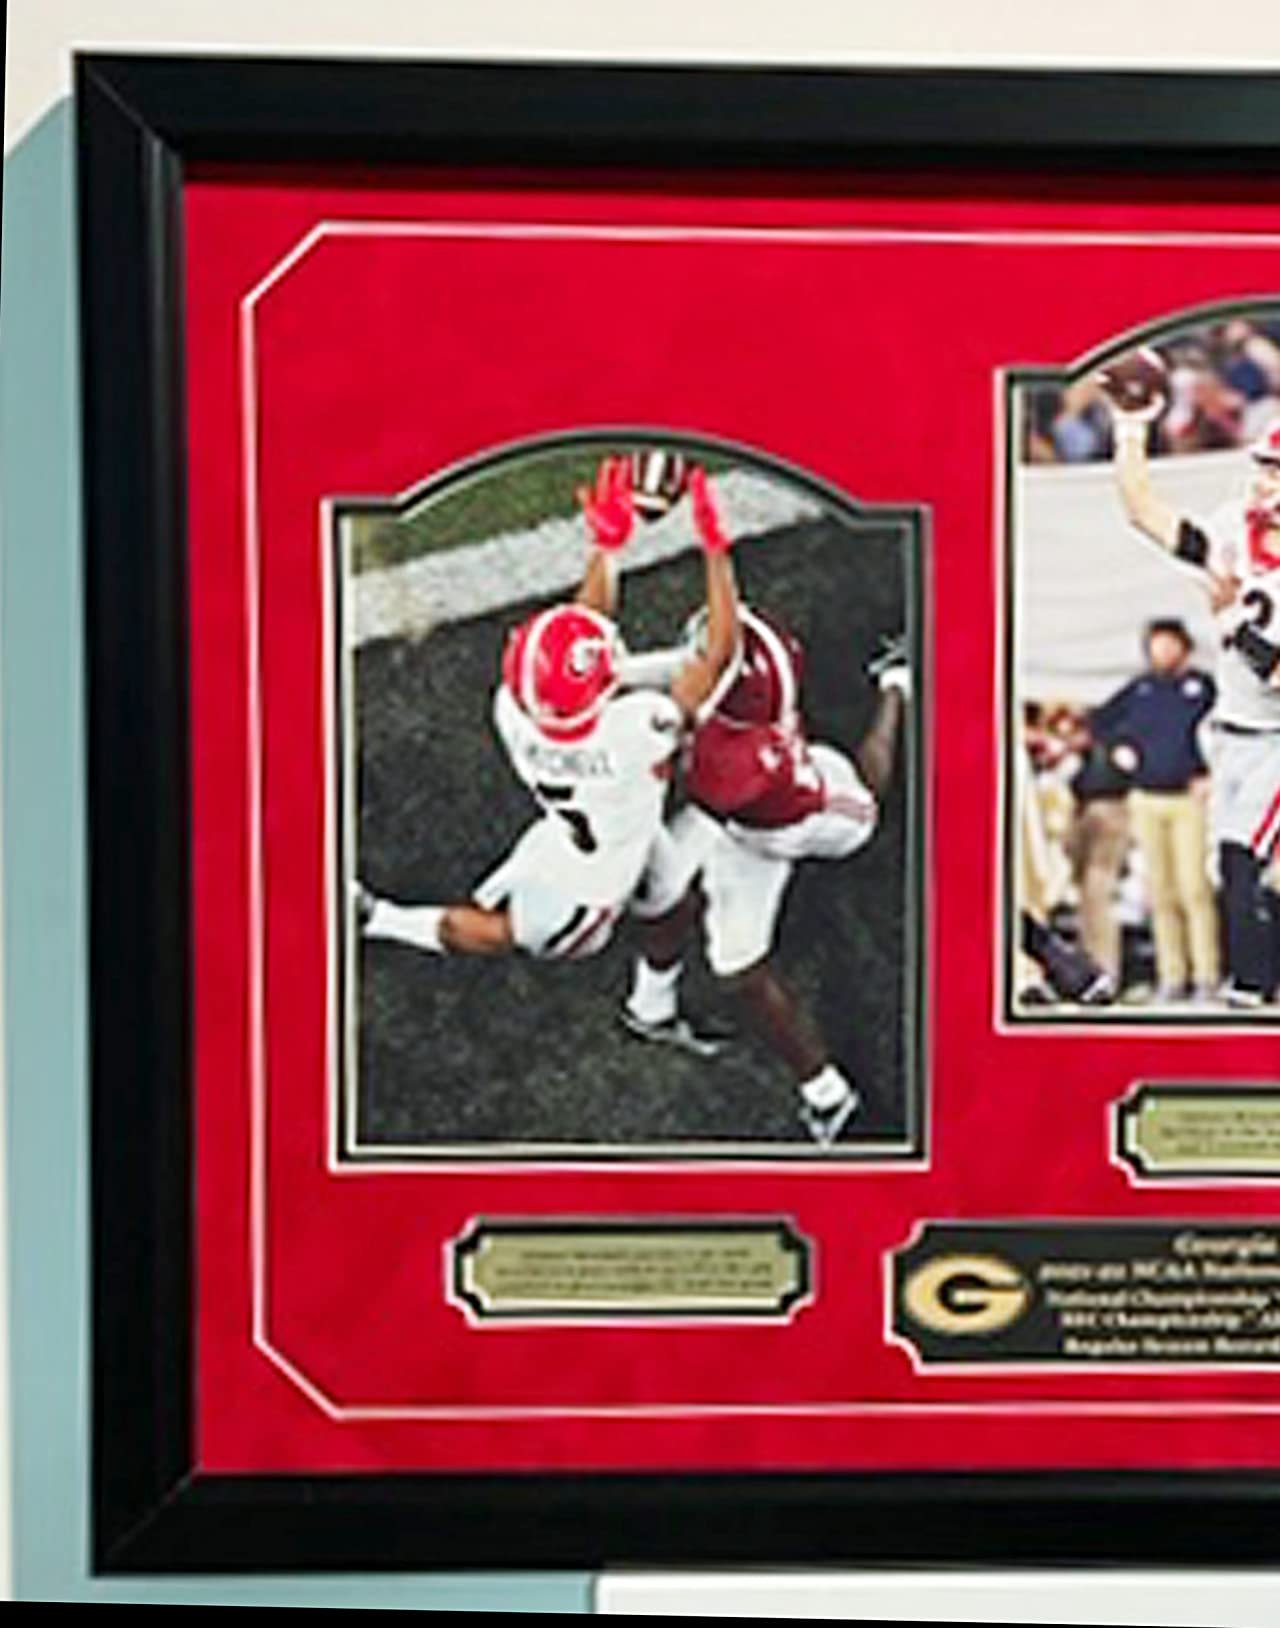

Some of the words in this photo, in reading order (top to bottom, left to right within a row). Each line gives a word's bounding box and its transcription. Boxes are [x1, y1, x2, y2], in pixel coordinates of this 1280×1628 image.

[536, 781, 598, 855] 5
[1173, 1231, 1277, 1258] Georgia
[1131, 1261, 1196, 1281] NCAA
[904, 1255, 1027, 1333] G
[1045, 1290, 1127, 1308] National
[1130, 1289, 1270, 1309] Championship
[1099, 1311, 1242, 1332] Championship
[1063, 1337, 1138, 1355] Regular
